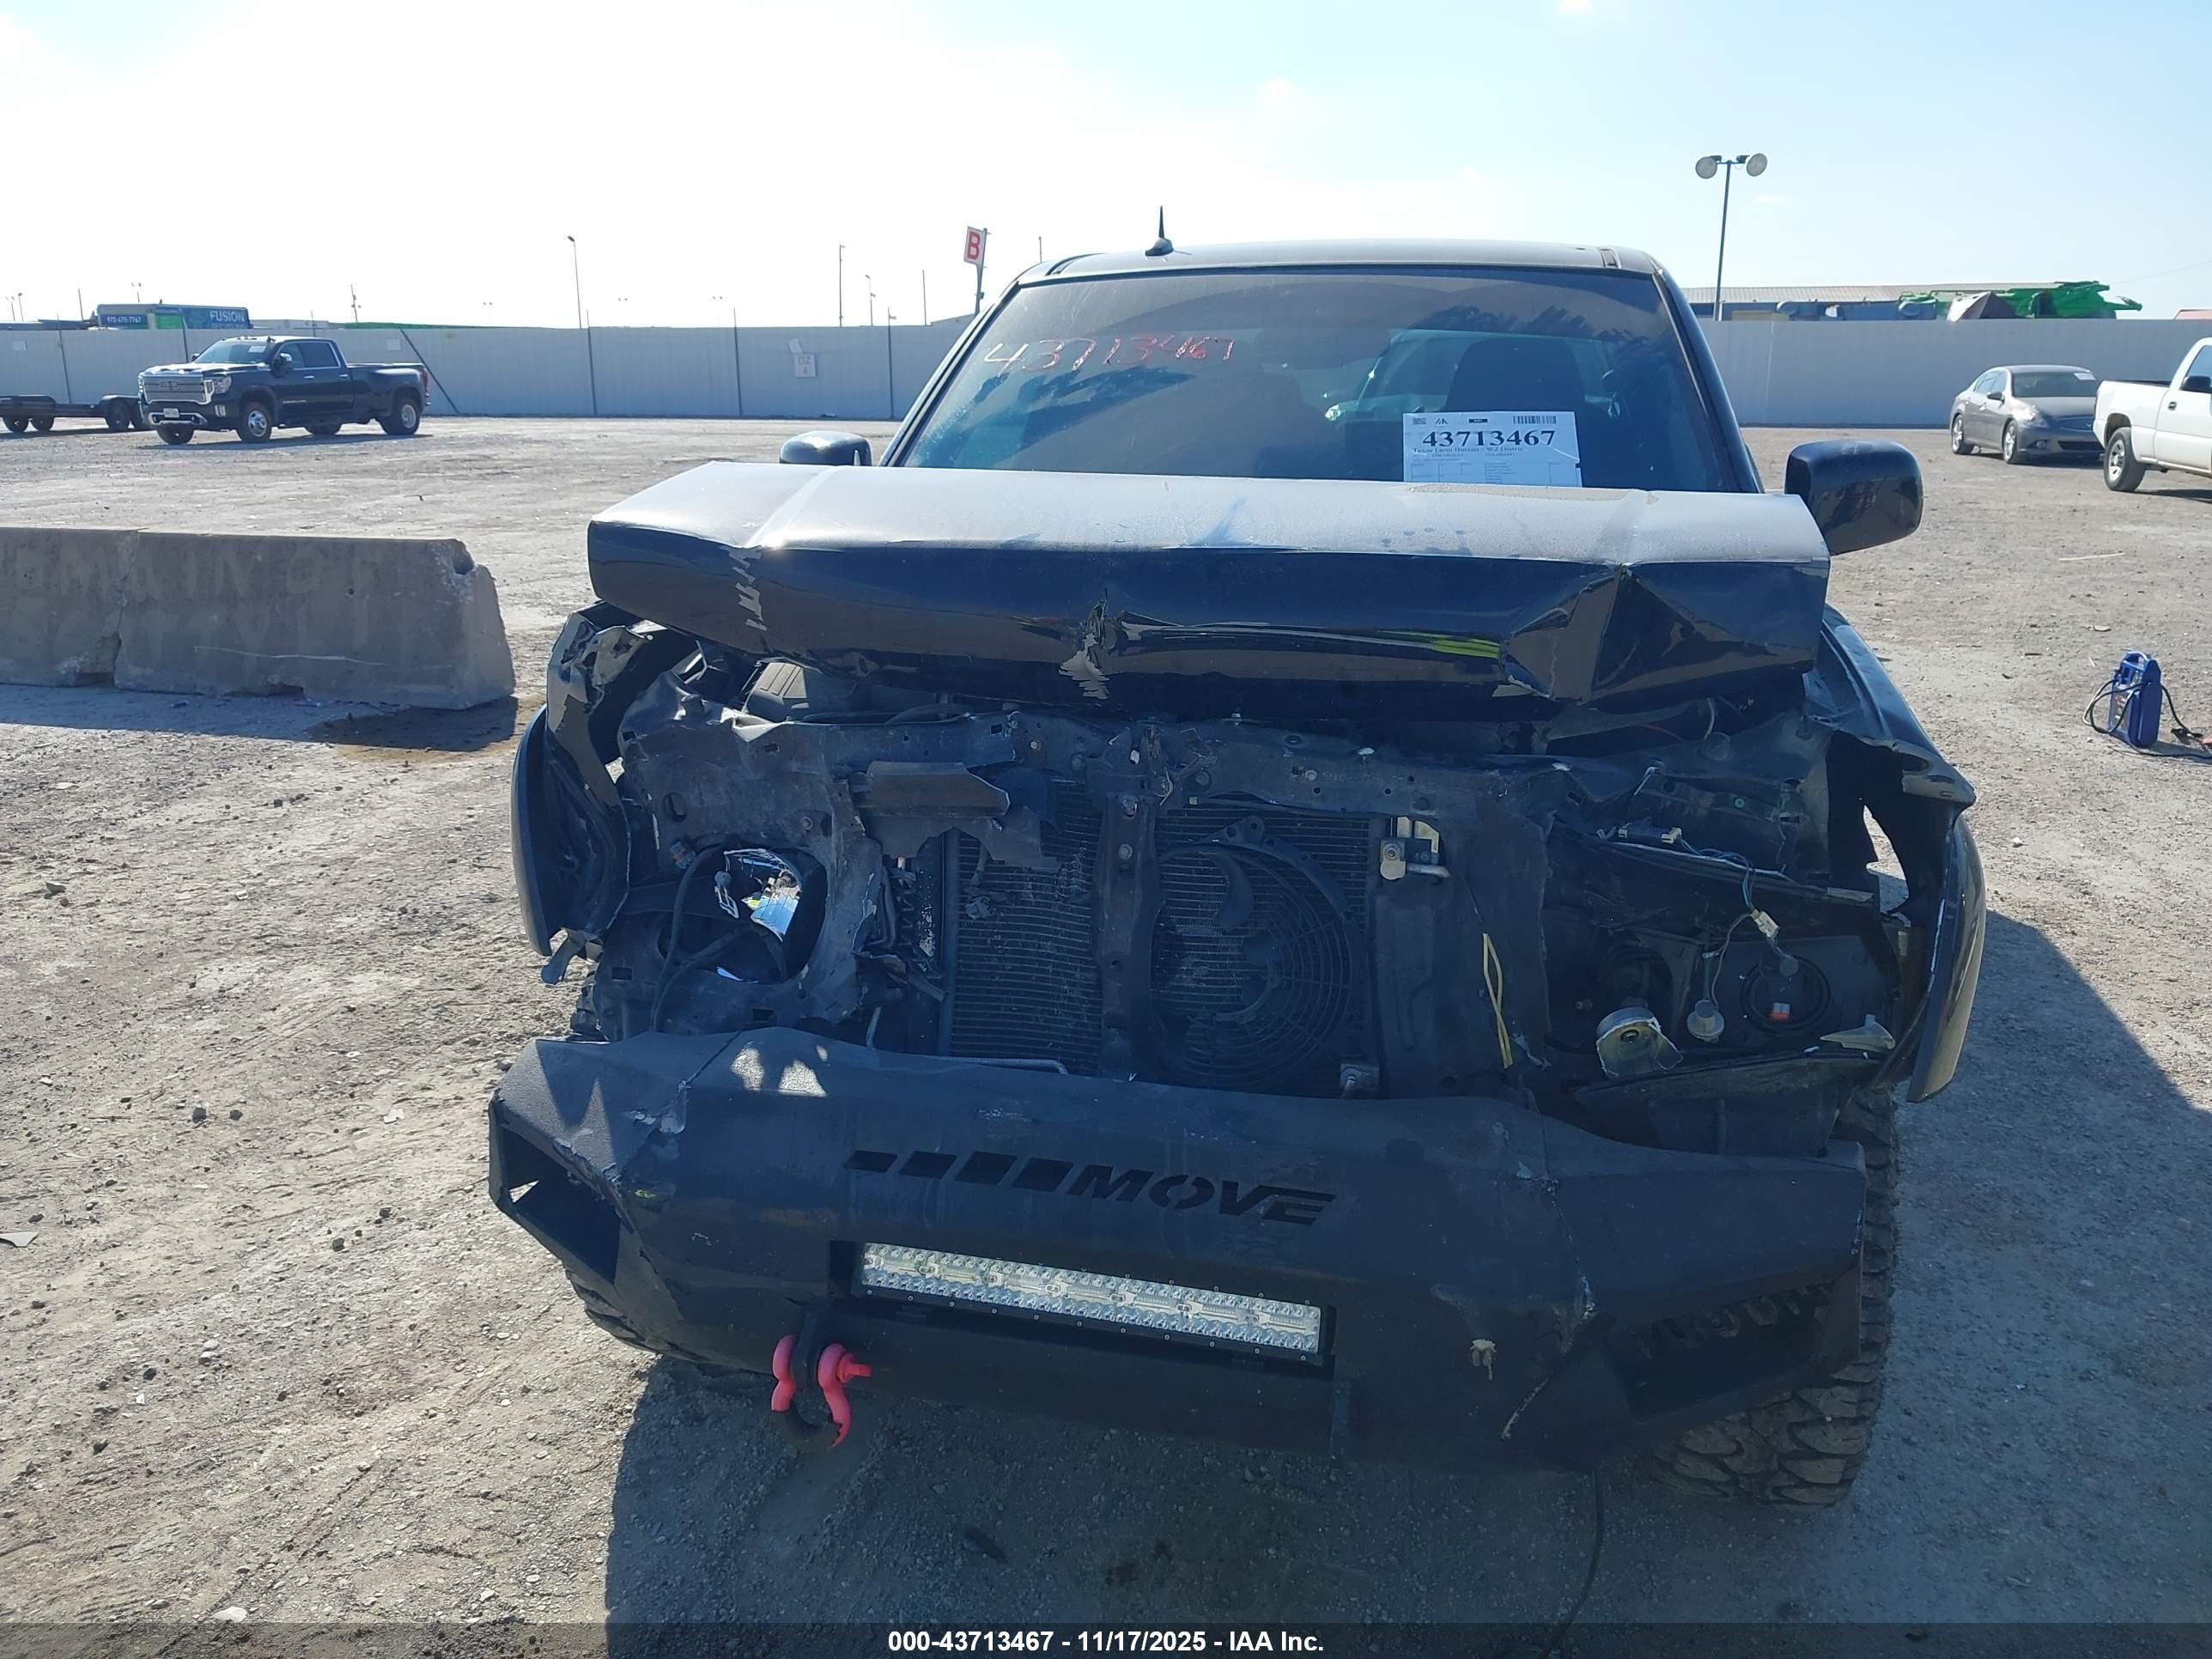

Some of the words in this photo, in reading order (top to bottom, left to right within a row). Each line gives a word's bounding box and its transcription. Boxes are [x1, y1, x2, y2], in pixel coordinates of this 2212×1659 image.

[968, 232, 981, 259] B
[210, 310, 246, 323] FUSION
[1422, 430, 1556, 447] 43713467
[1066, 1164, 1338, 1225] MOVE
